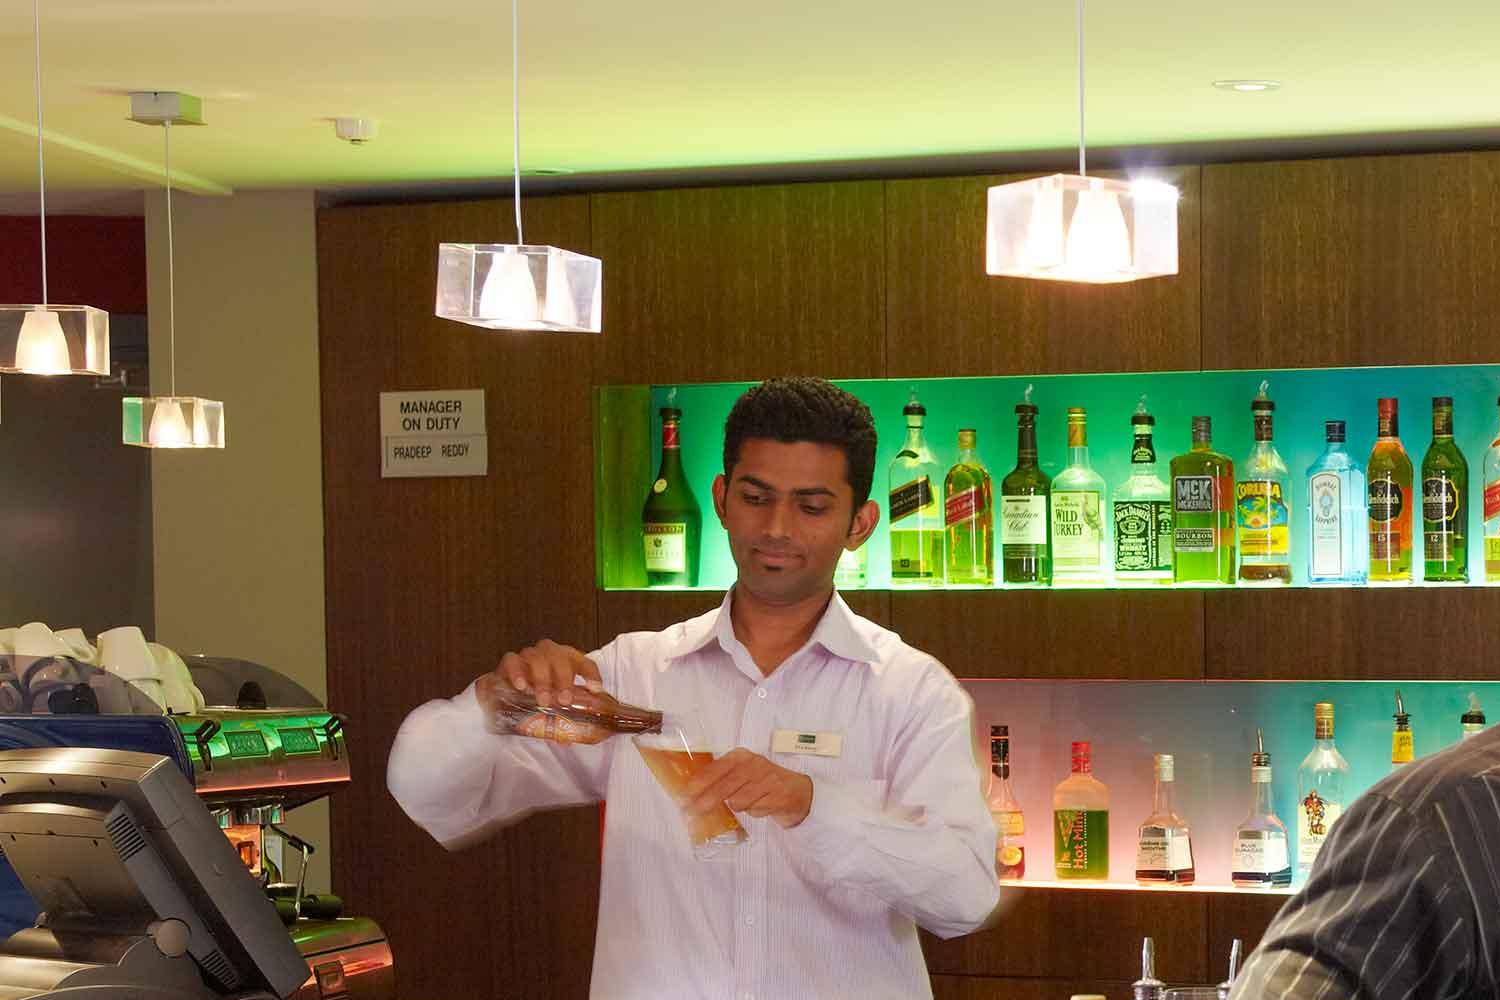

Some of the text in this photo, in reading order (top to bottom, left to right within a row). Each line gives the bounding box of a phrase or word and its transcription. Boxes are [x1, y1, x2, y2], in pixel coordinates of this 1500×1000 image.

[400, 400, 462, 414] MANAGER
[402, 416, 460, 431] ON DUTY
[393, 443, 469, 459] PRADEEP REDDY
[1055, 509, 1078, 523] WILD
[1054, 522, 1084, 537] TURKEY
[1072, 844, 1084, 869] Hot
